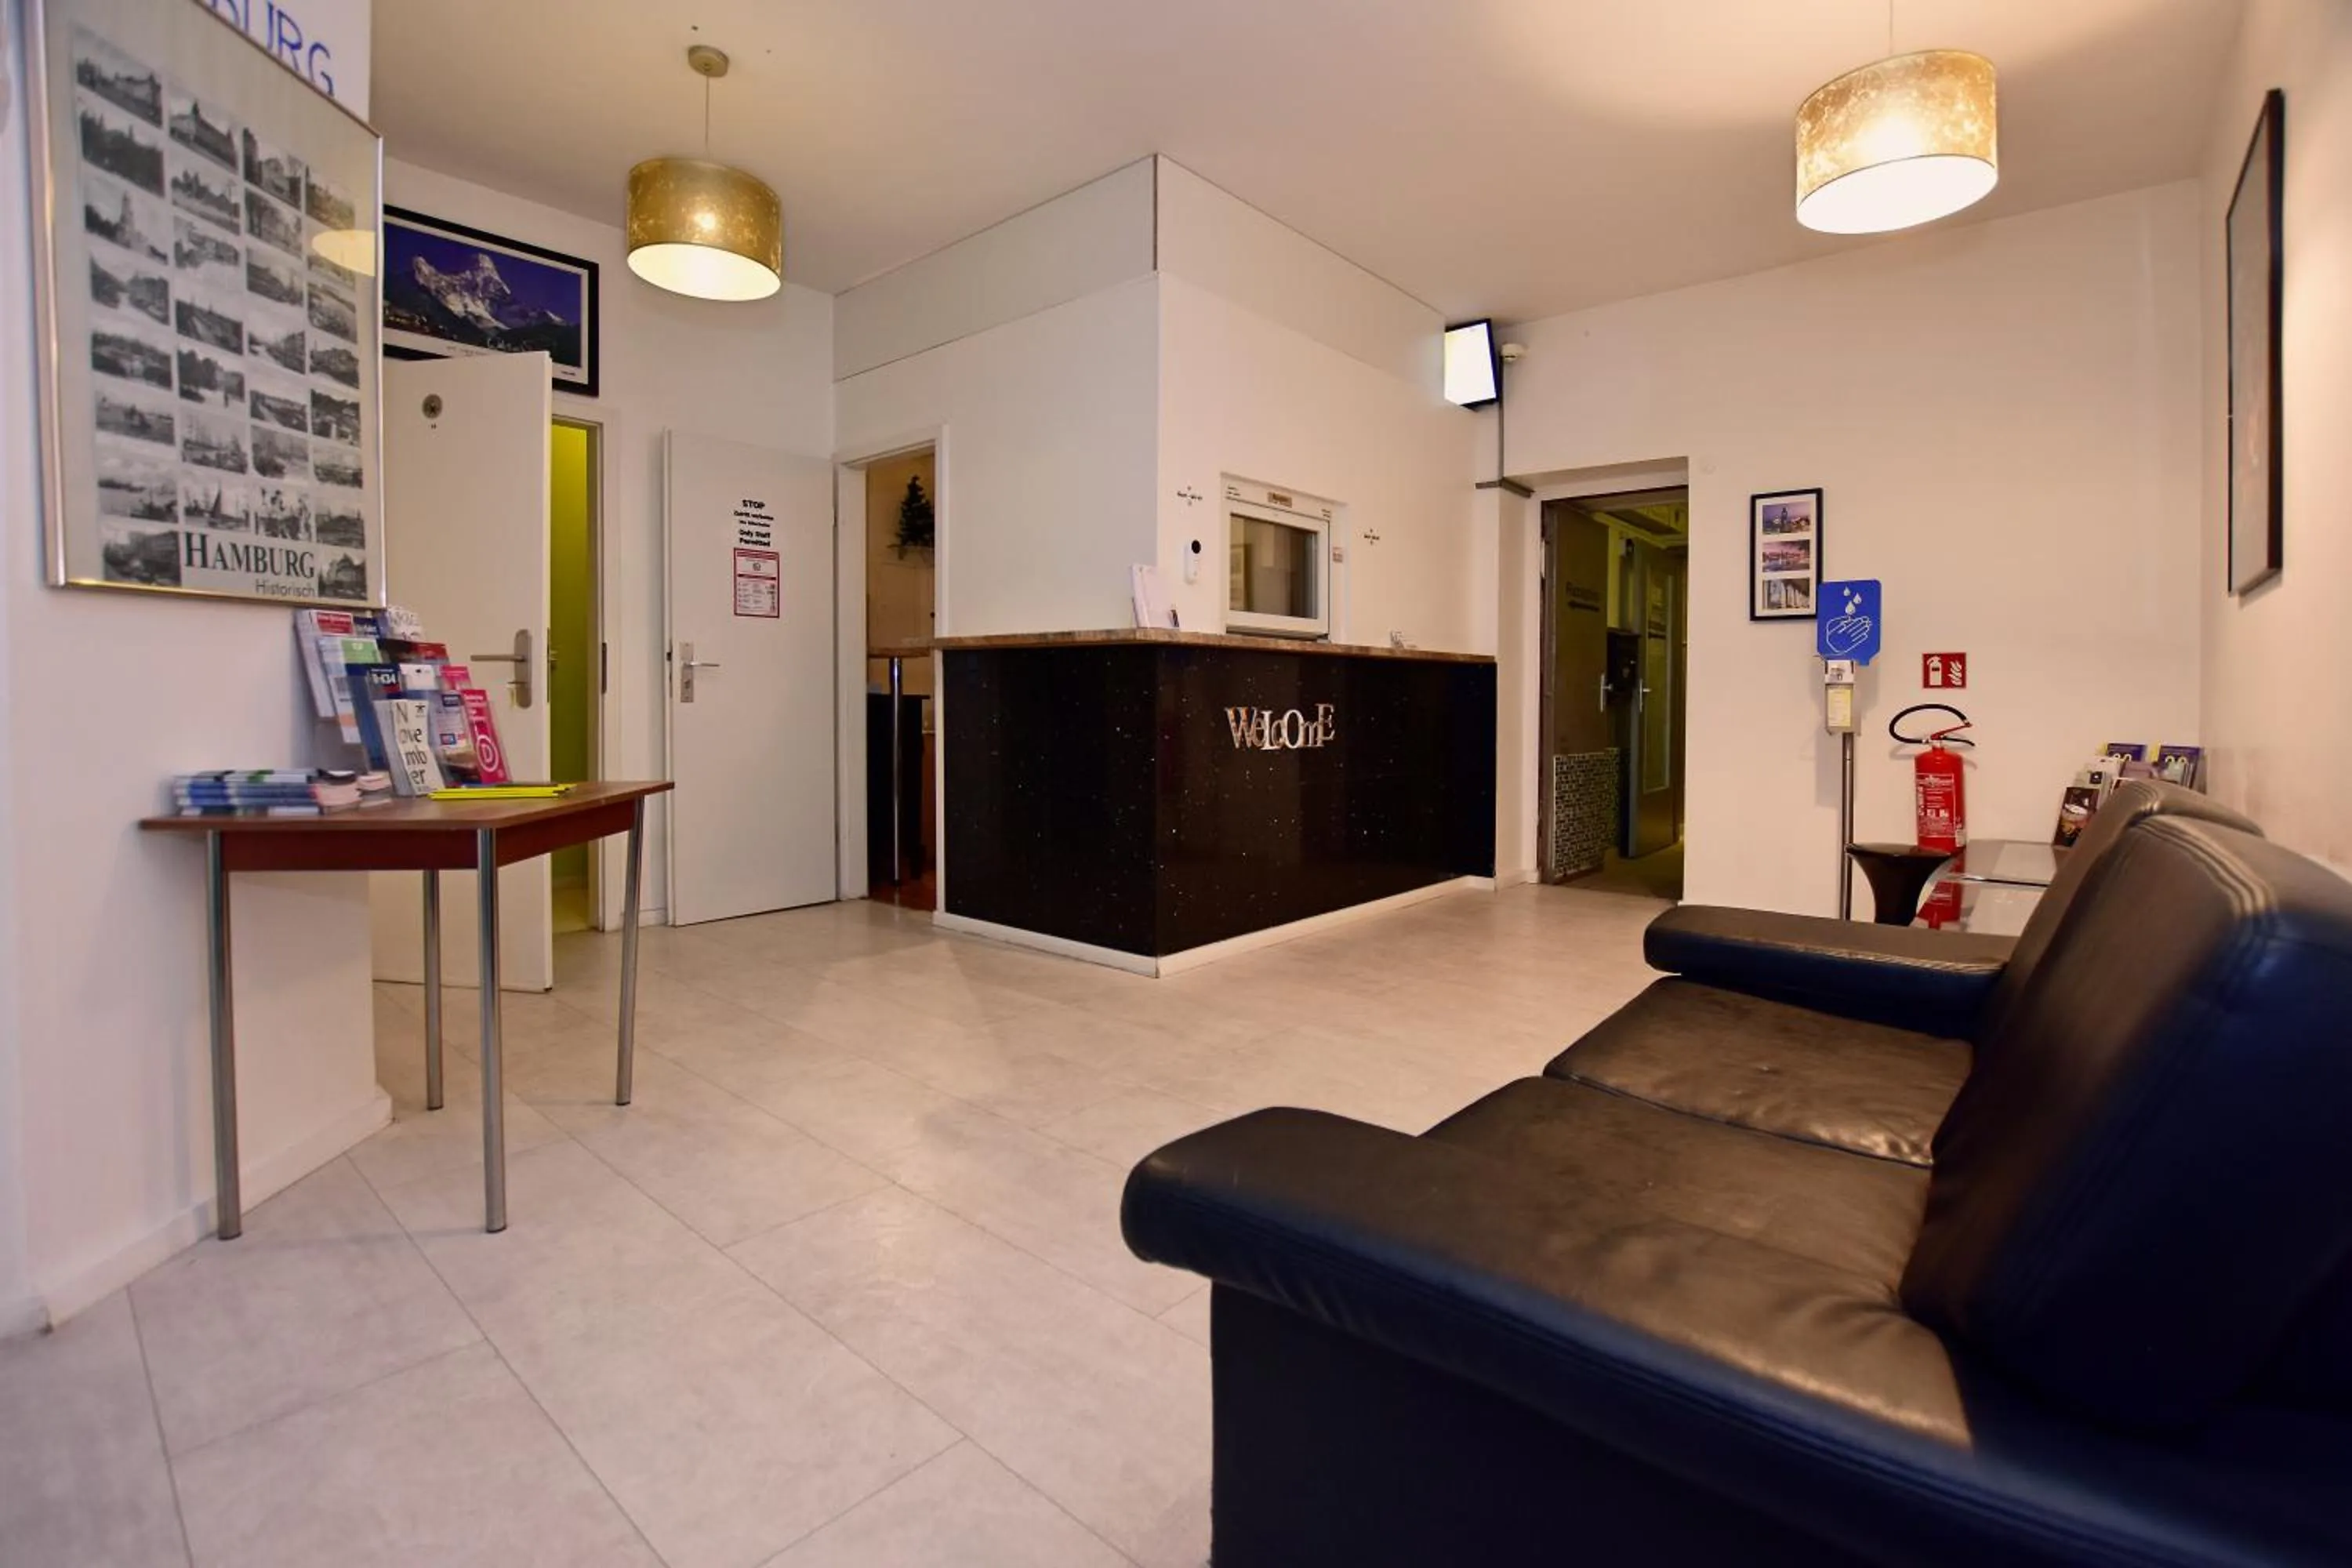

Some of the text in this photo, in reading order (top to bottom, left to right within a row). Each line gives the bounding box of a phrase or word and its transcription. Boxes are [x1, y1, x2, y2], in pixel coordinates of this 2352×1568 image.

[742, 499, 765, 509] STOP
[739, 528, 753, 538] Only
[184, 532, 314, 579] HAMBURG
[255, 578, 315, 597] Historisch
